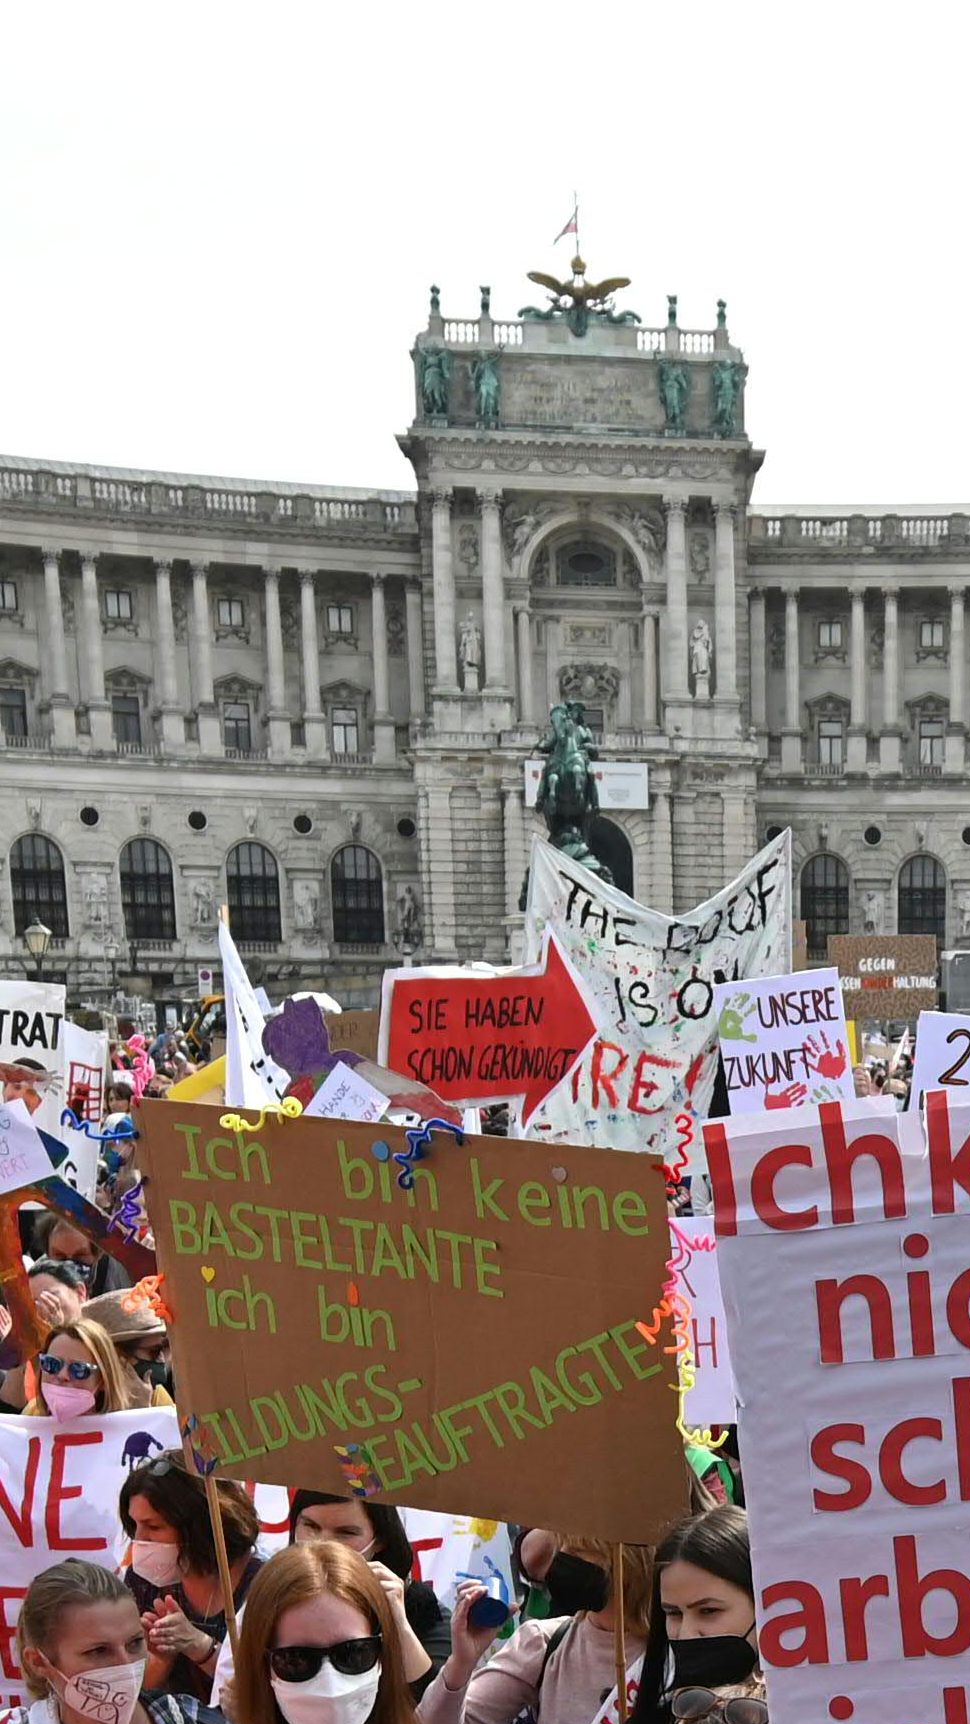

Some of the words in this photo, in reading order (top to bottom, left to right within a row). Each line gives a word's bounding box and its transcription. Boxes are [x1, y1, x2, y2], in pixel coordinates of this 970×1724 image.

[559, 870, 647, 947] THE
[859, 957, 896, 971] GEGEN
[409, 998, 449, 1034] SIE
[465, 995, 544, 1029] HABEN
[614, 977, 659, 1027] IS
[757, 986, 839, 1029] UNSERE
[407, 1045, 475, 1085] SCHON
[477, 1040, 577, 1081] GEKÜNDIGT
[724, 1045, 813, 1090] ZUKUNFT
[173, 1122, 271, 1185] Ich
[337, 1139, 440, 1212] bin
[469, 1157, 649, 1237] keine
[703, 1102, 905, 1236] Ich
[169, 1199, 503, 1299] BASTELTANTE
[200, 1264, 276, 1335] ich
[317, 1281, 397, 1352] bin
